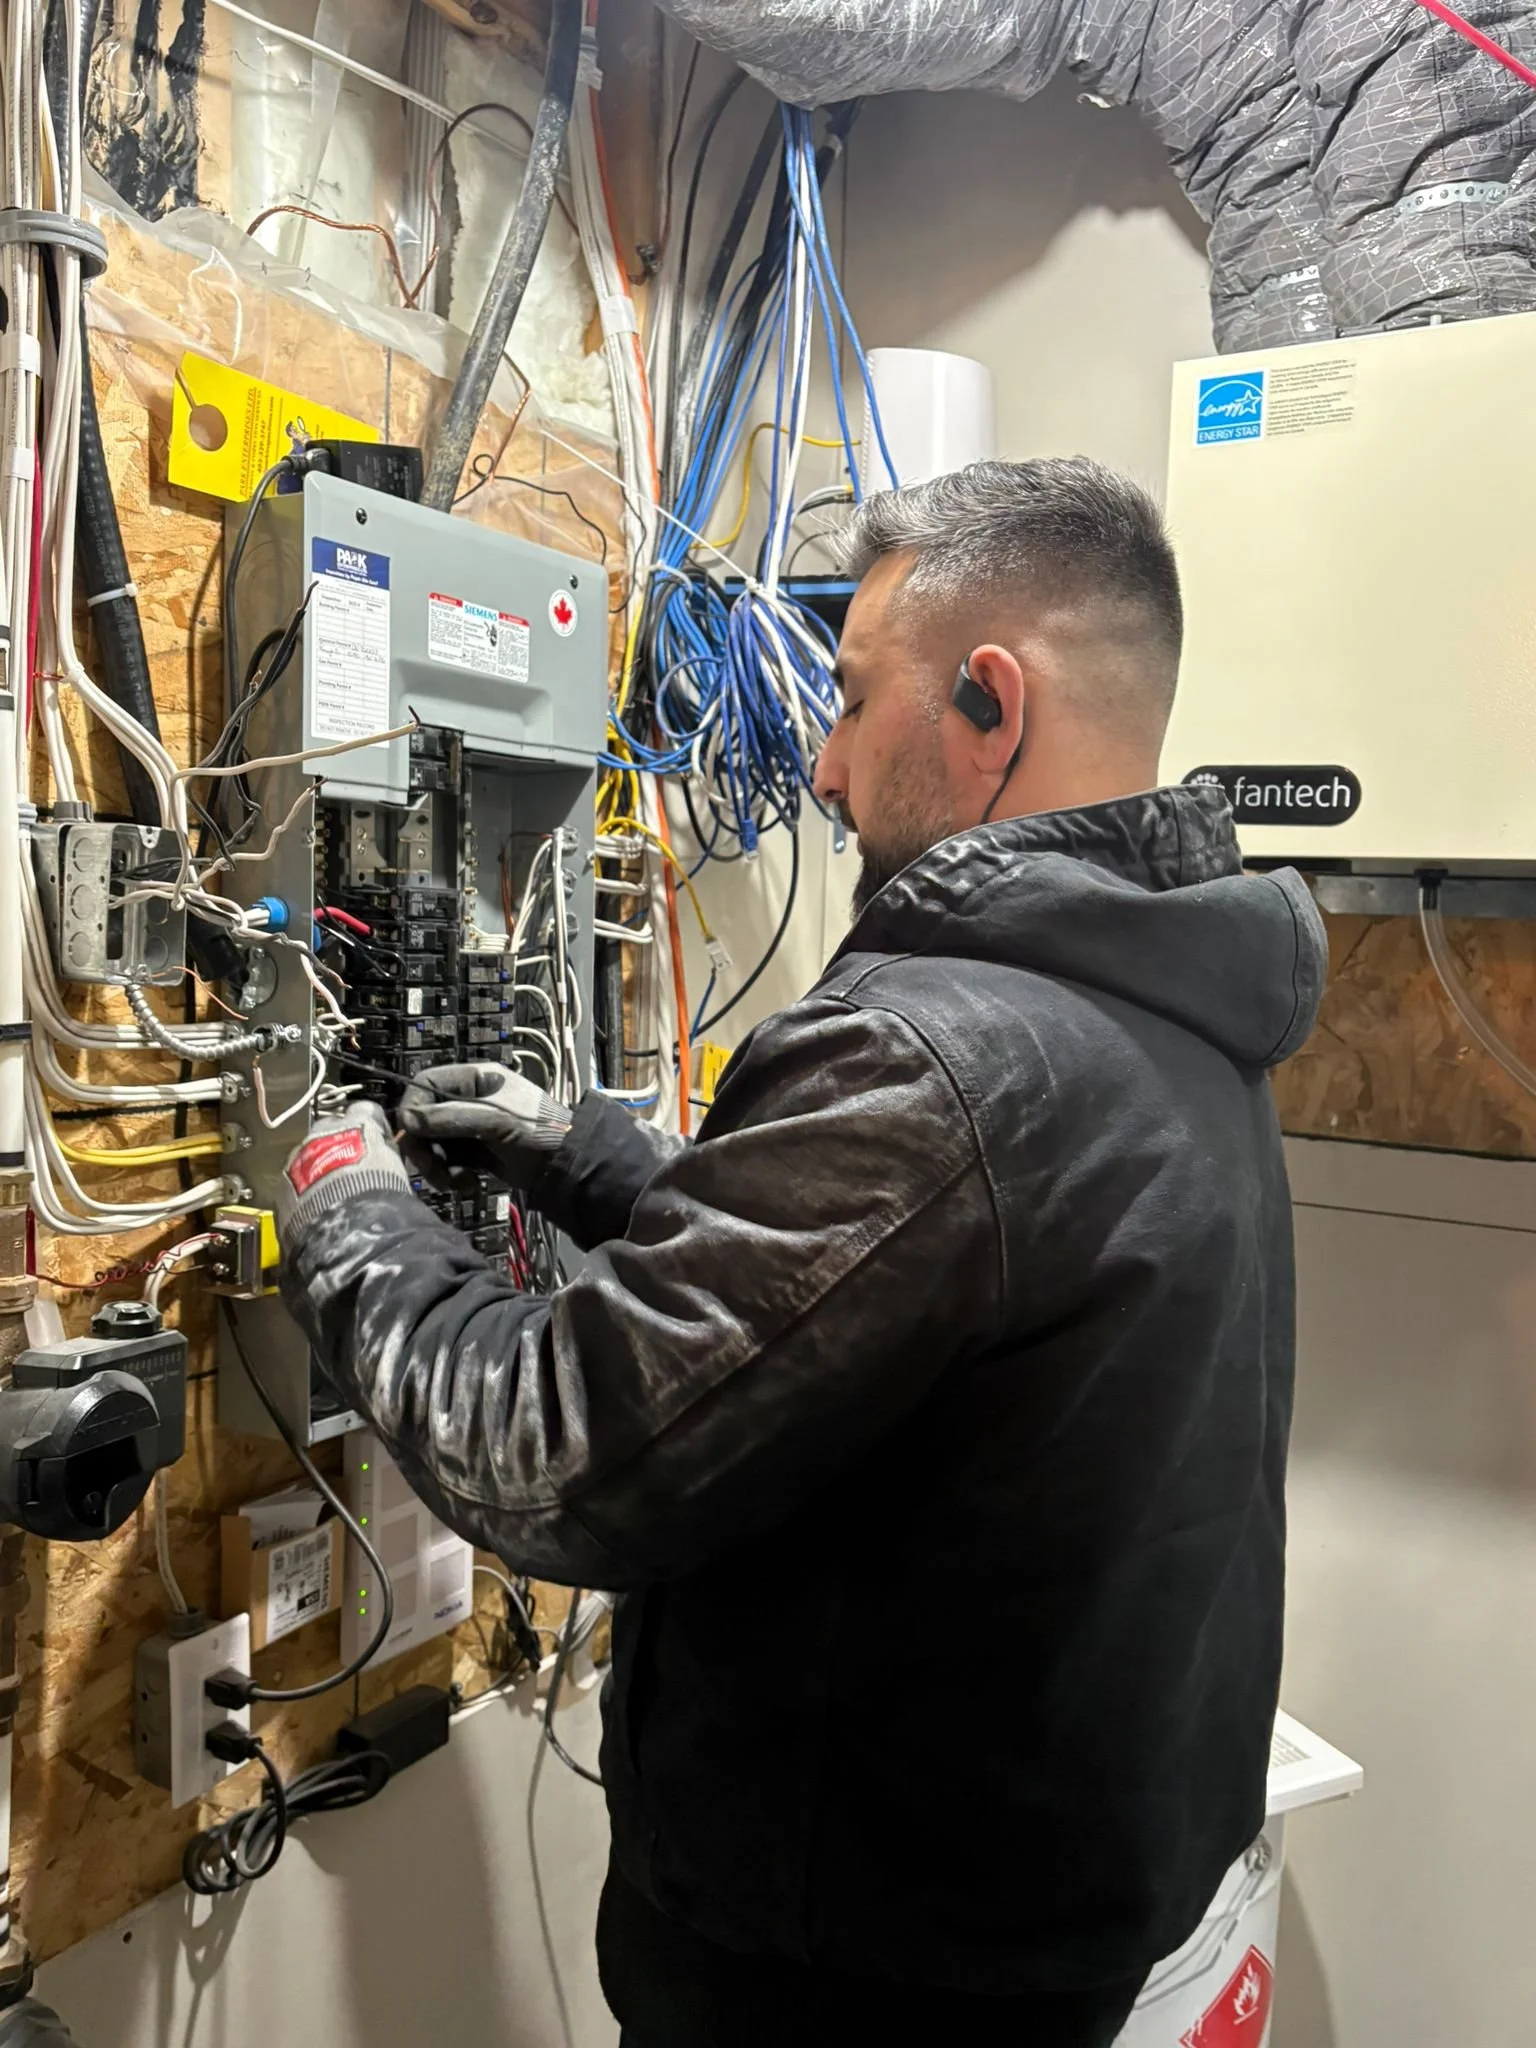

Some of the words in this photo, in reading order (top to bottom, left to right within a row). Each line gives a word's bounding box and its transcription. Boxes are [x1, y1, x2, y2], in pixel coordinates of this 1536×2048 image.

[1199, 427, 1233, 442] ENERGY
[1235, 425, 1259, 438] STAR
[463, 604, 498, 622] SIEMENS
[1233, 775, 1351, 808] fantech
